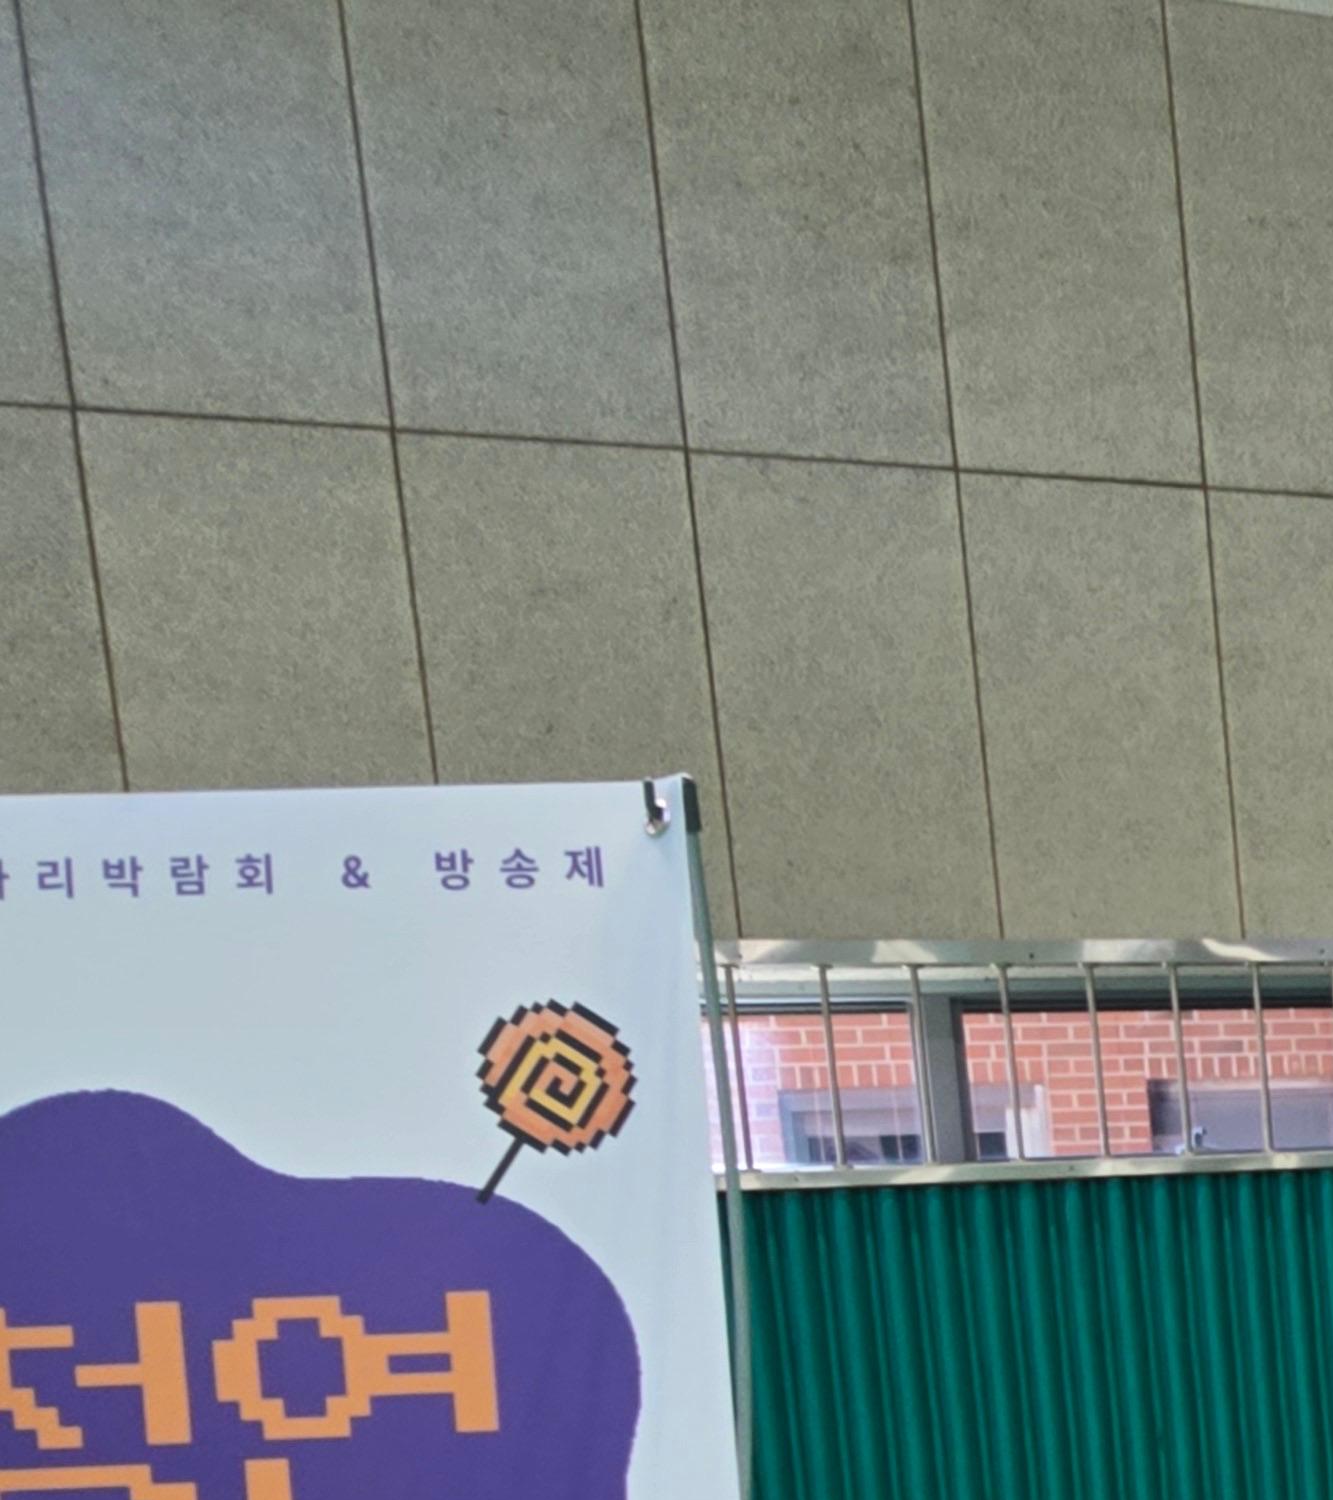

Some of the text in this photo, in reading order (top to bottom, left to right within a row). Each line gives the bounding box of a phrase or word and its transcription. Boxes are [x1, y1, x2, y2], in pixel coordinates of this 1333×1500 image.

[0, 846, 604, 899] 리박람회 & 방송제
